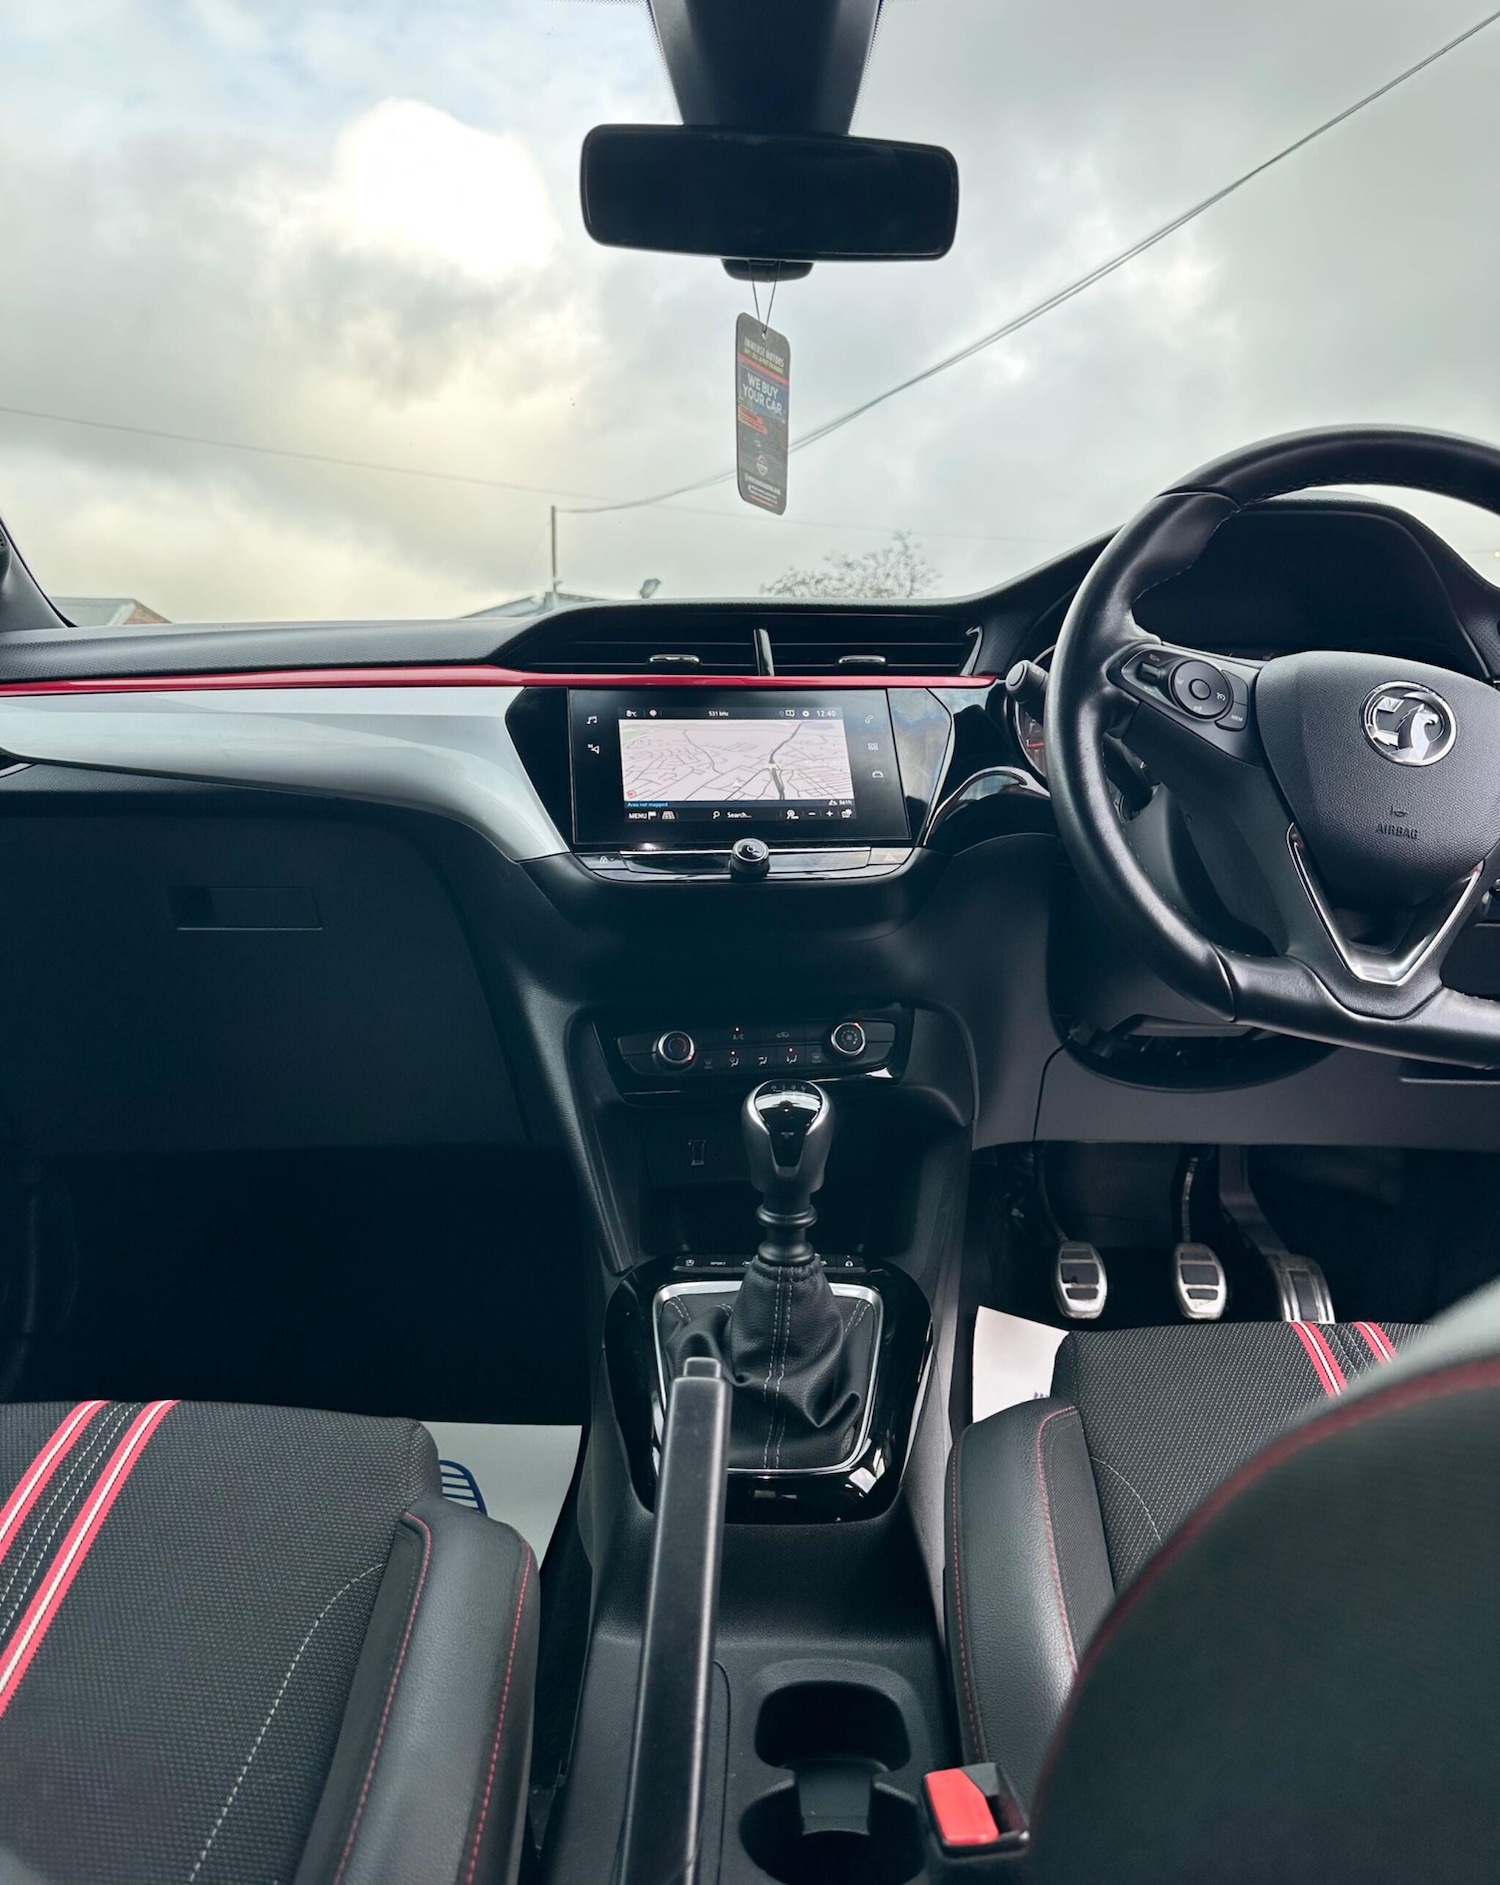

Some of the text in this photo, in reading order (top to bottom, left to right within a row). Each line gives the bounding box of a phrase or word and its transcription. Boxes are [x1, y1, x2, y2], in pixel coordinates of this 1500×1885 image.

[747, 372, 779, 399] WE BUY
[742, 383, 784, 415] YOUR CAR
[1231, 714, 1243, 722] MEM
[1376, 823, 1418, 840] AIRBAG
